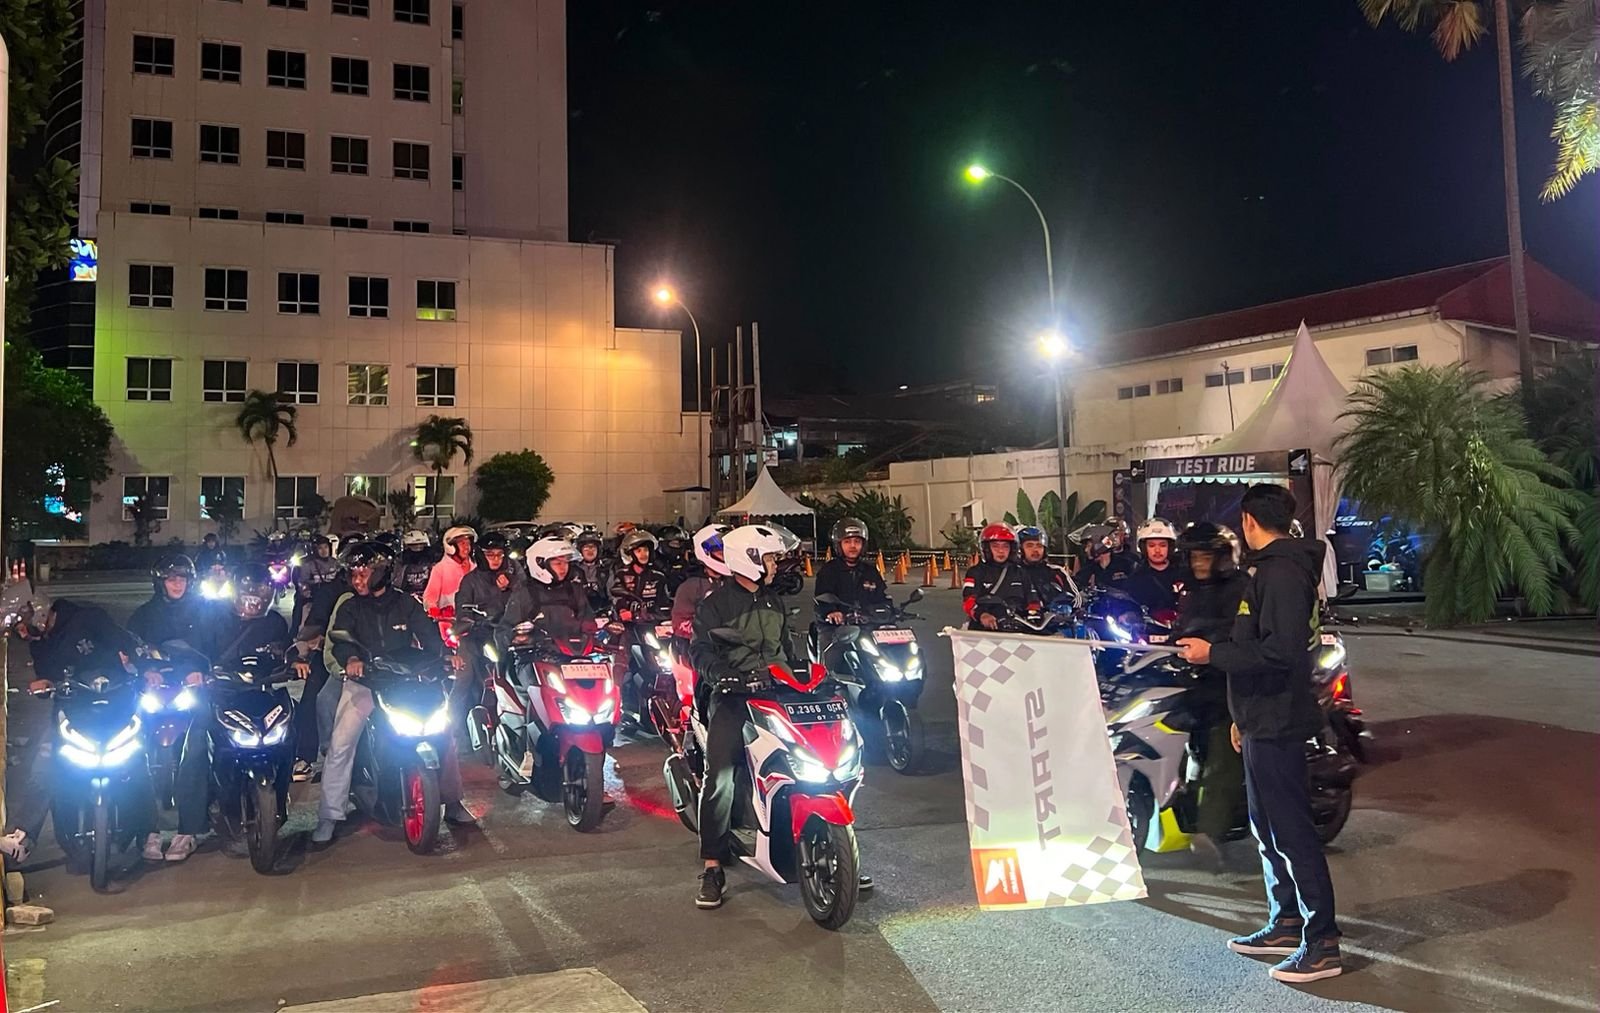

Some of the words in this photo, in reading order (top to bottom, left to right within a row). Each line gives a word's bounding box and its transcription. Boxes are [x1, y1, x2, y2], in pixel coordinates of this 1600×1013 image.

[1175, 457, 1215, 475] TEST
[1217, 455, 1256, 473] RIDE
[788, 706, 795, 715] D
[799, 704, 821, 714] 2366
